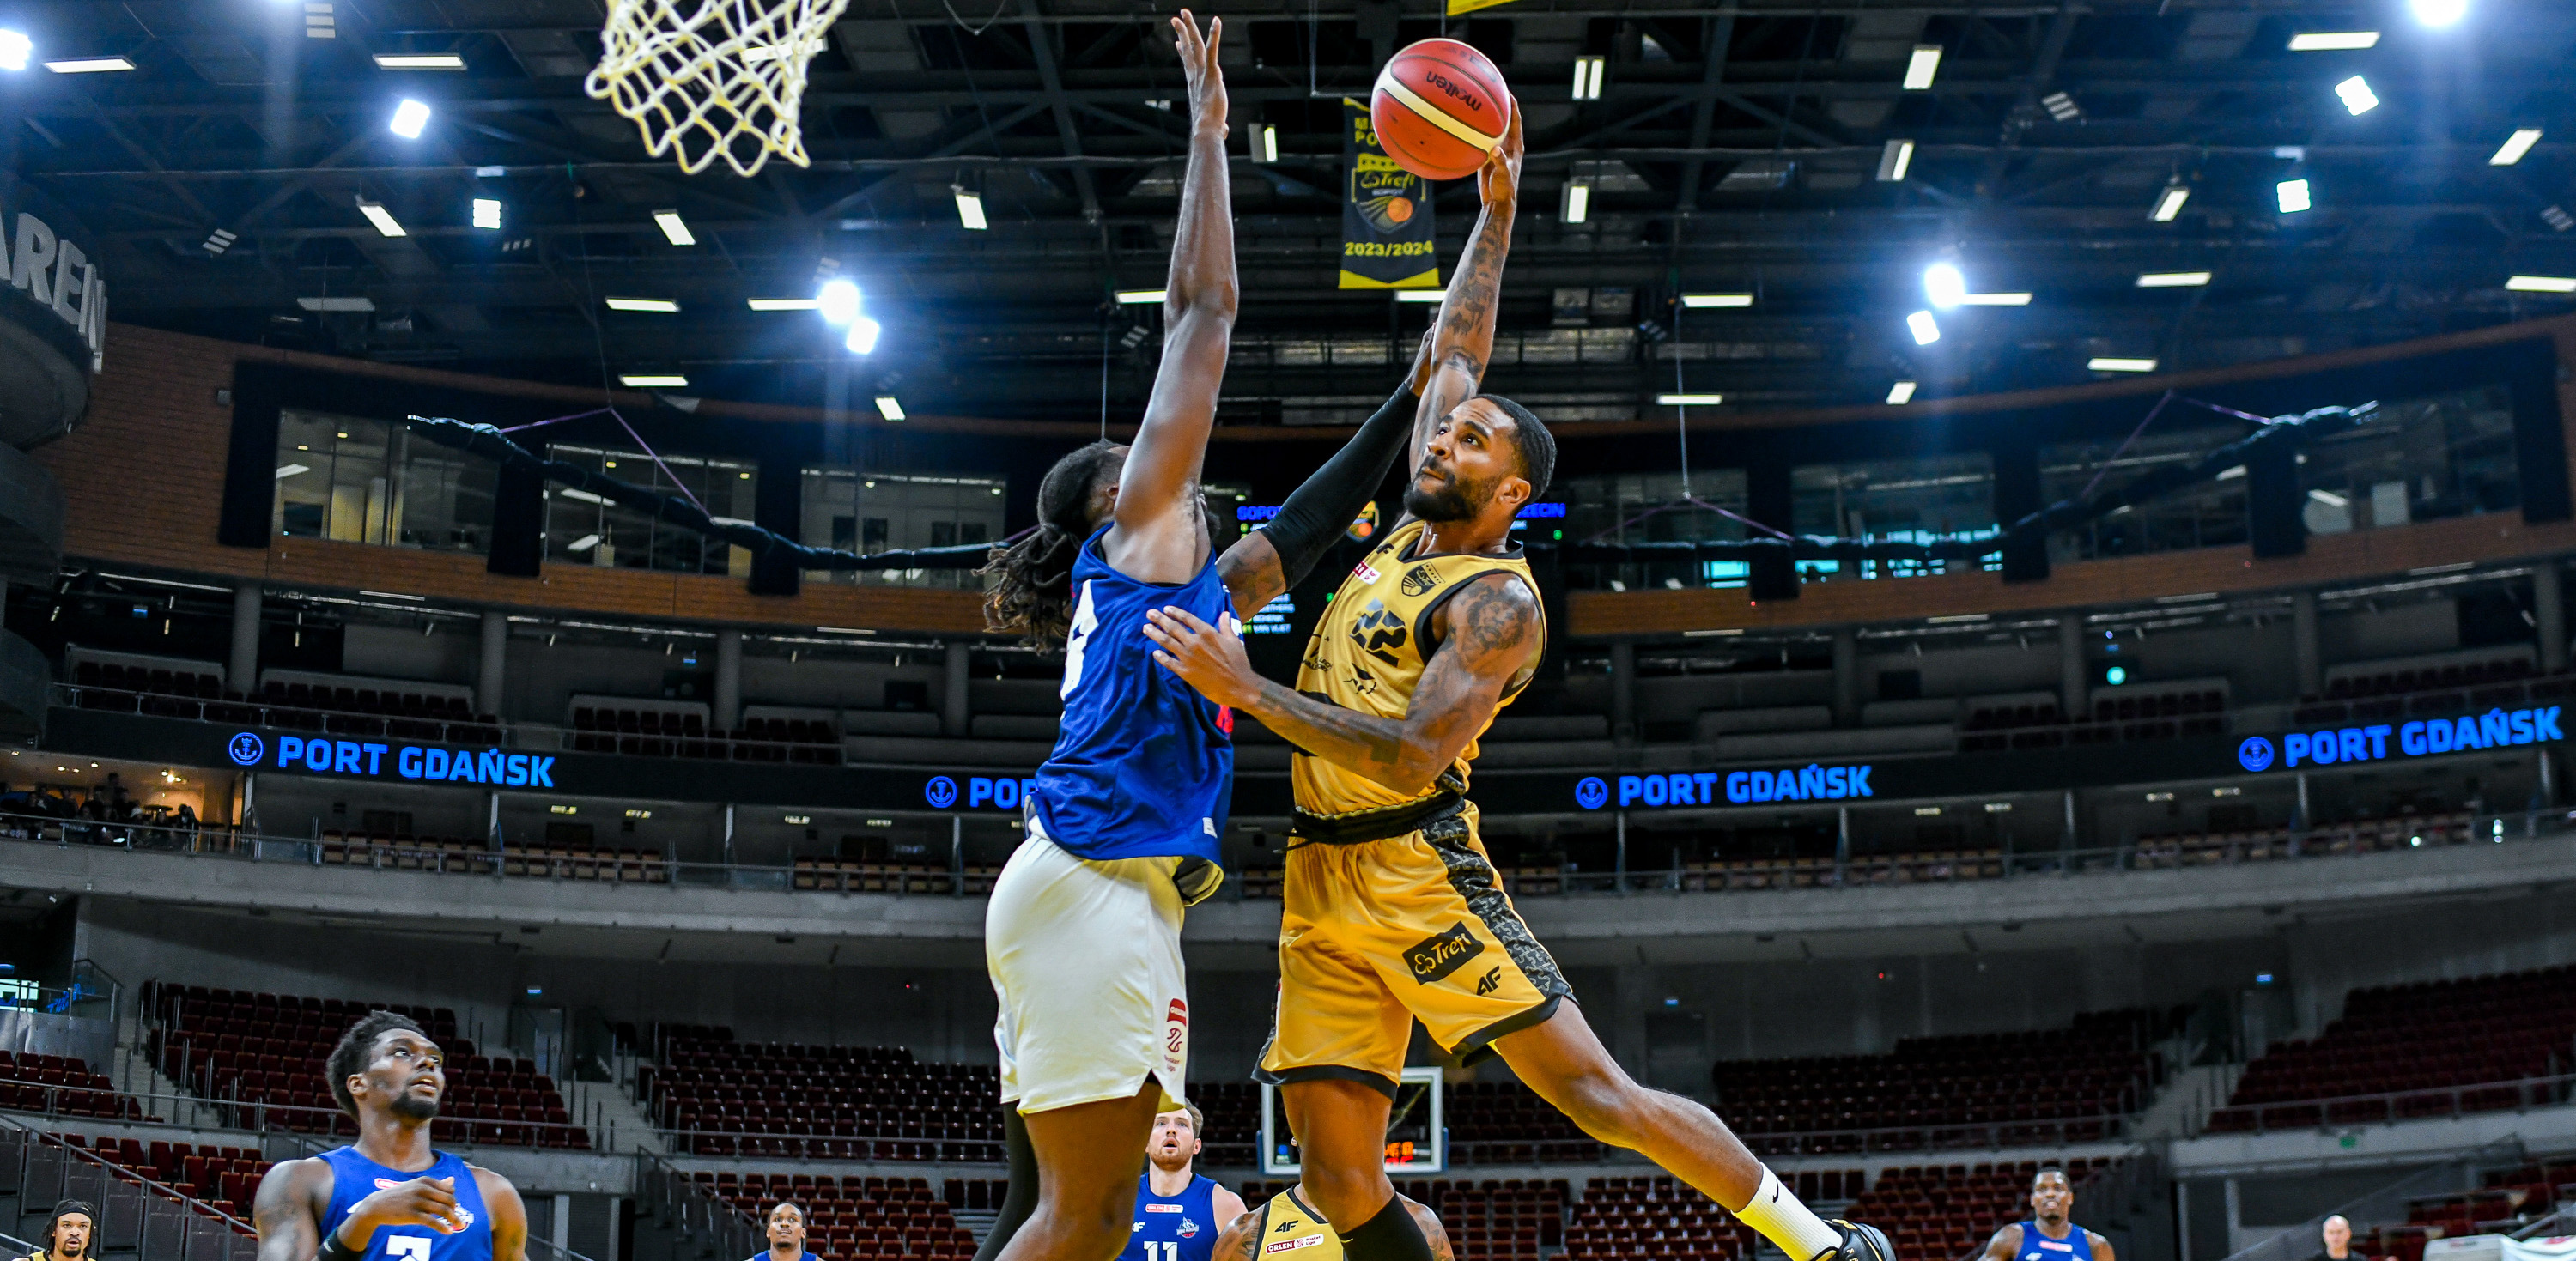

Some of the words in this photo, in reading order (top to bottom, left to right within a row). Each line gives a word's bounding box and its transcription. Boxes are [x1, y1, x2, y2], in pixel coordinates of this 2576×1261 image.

[1426, 70, 1482, 111] molten
[1355, 118, 1374, 130] M
[1345, 240, 1434, 257] 2023/2024
[1349, 597, 1407, 668] 22
[2285, 725, 2391, 767] PORT
[2401, 706, 2562, 755] GDAŃSK
[278, 737, 388, 774] PORT
[399, 747, 555, 787] GDAŃSK
[1619, 773, 1717, 806] PORT
[1727, 763, 1872, 803] GDAŃSK
[1144, 1241, 1177, 1261] 11
[1267, 1242, 1293, 1252] ORLEN
